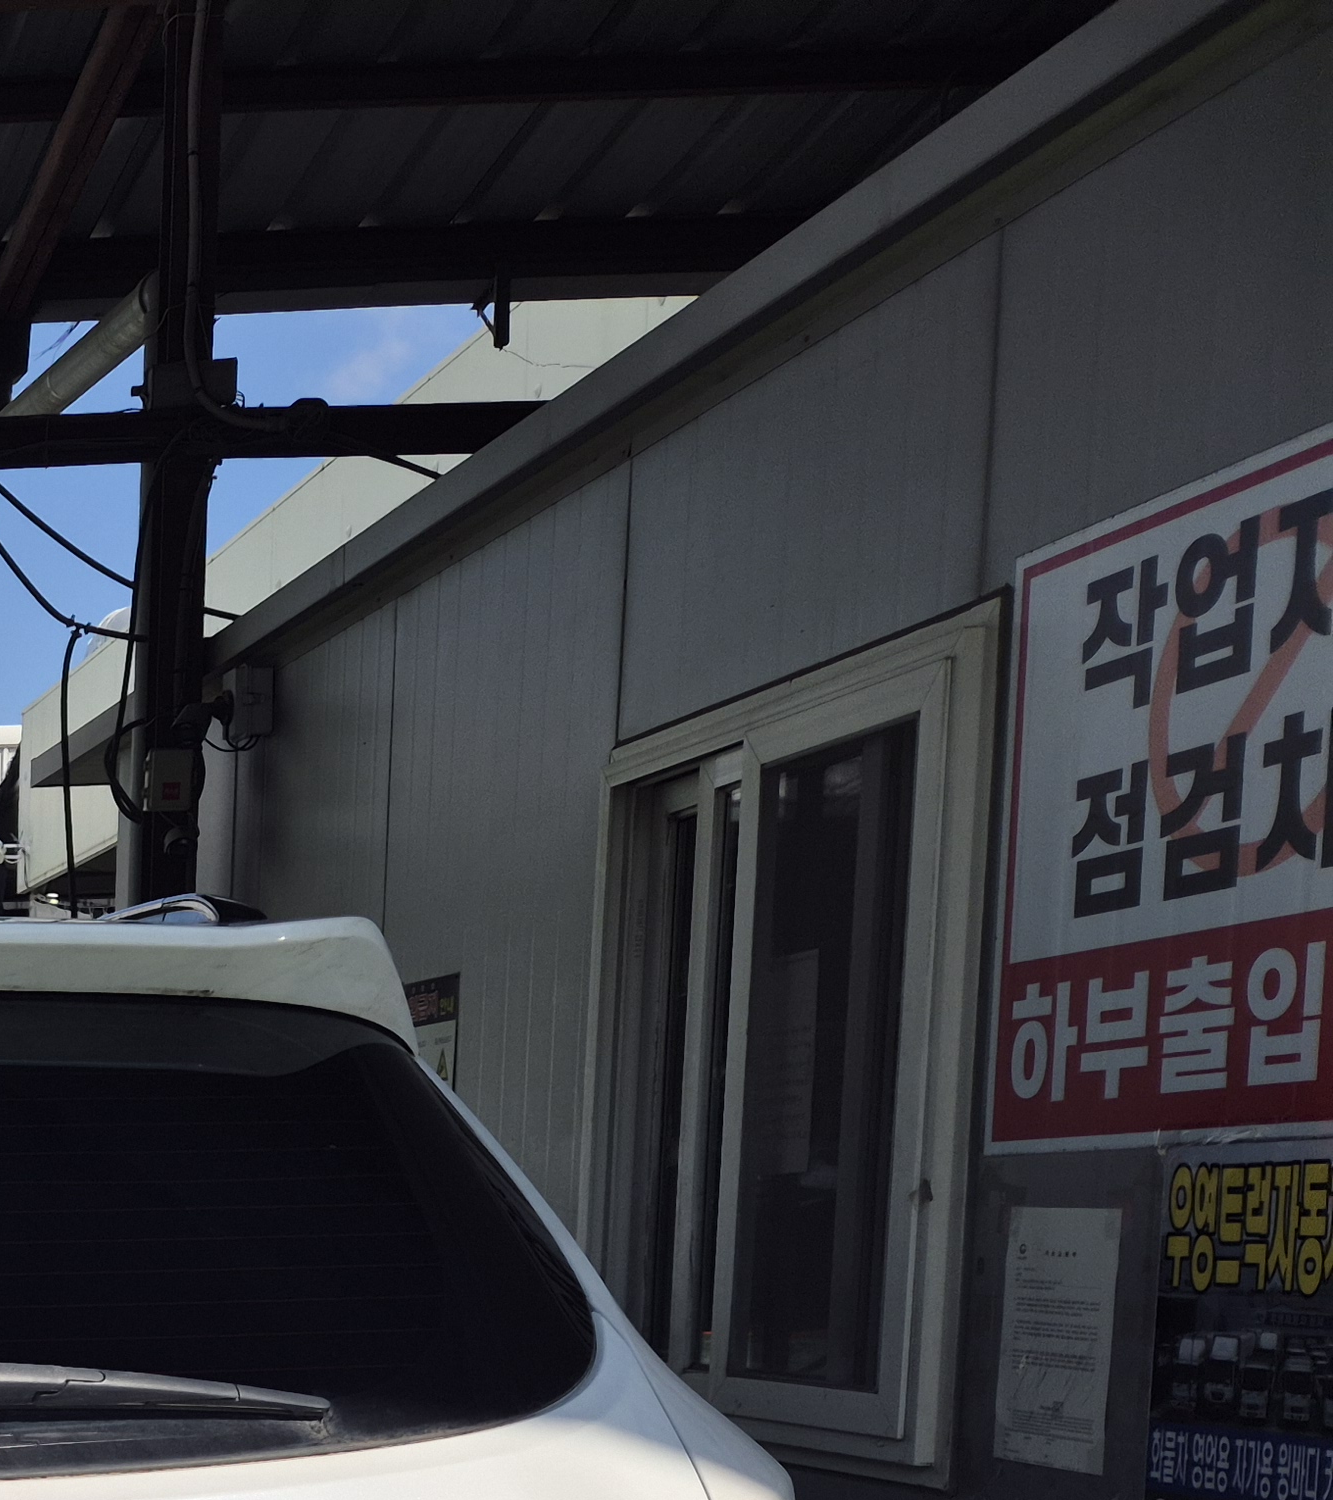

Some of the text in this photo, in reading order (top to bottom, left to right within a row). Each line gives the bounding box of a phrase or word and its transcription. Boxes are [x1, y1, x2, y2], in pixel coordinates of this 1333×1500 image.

[1010, 940, 1326, 1102] 하부출입
[1166, 1159, 1333, 1297] 우영트럭자동
[1150, 1428, 1189, 1486] 화물차
[1191, 1433, 1230, 1493] 영업용
[1232, 1438, 1274, 1499] 자가용
